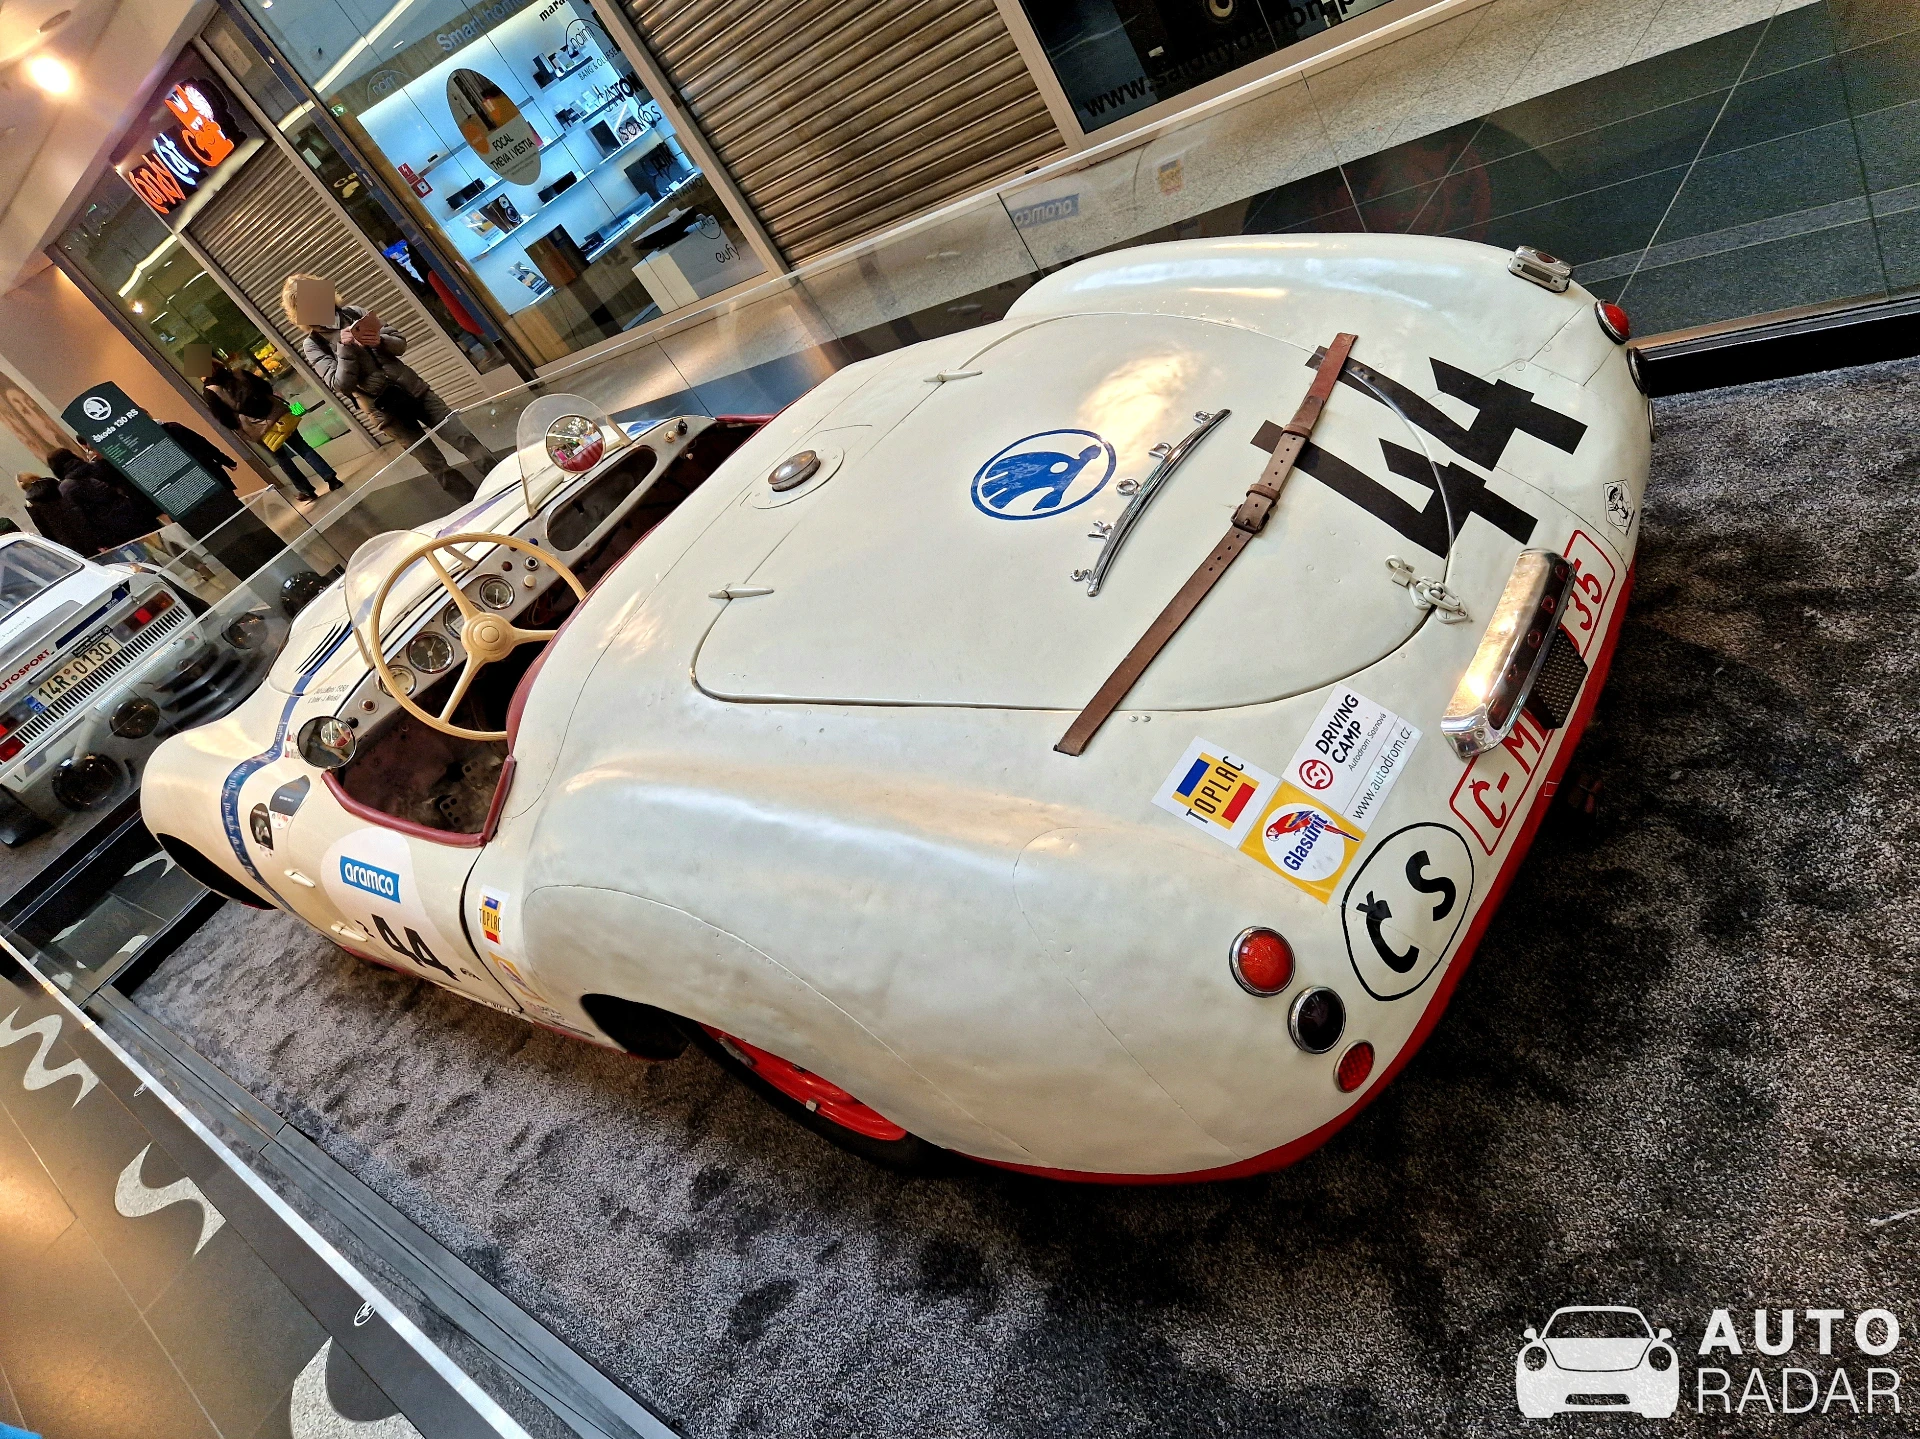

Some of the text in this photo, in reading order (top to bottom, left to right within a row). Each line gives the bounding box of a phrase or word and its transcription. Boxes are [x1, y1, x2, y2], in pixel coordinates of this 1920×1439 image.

[539, 0, 570, 22] mara
[578, 65, 595, 81] BANG
[492, 132, 515, 152] FOCAL
[618, 105, 663, 141] SONOS
[489, 152, 512, 171] THEVA
[510, 137, 536, 157] VESTIA
[715, 243, 741, 264] eufy
[91, 408, 139, 443] Škoda 130 RS
[1249, 345, 1588, 562] 44
[37, 671, 71, 701] 14R
[72, 641, 114, 675] 0130
[1314, 693, 1360, 756] DRIVING
[1331, 720, 1362, 764] CAMP
[1348, 711, 1388, 772] Autodrom Sosnová
[1185, 755, 1244, 824] TOPLAC
[1352, 726, 1412, 820] www.autodrom.cz
[1283, 813, 1329, 871] Glasurit
[343, 861, 395, 898] aramco
[478, 907, 502, 933] TOPLAC
[371, 913, 462, 983] 44
